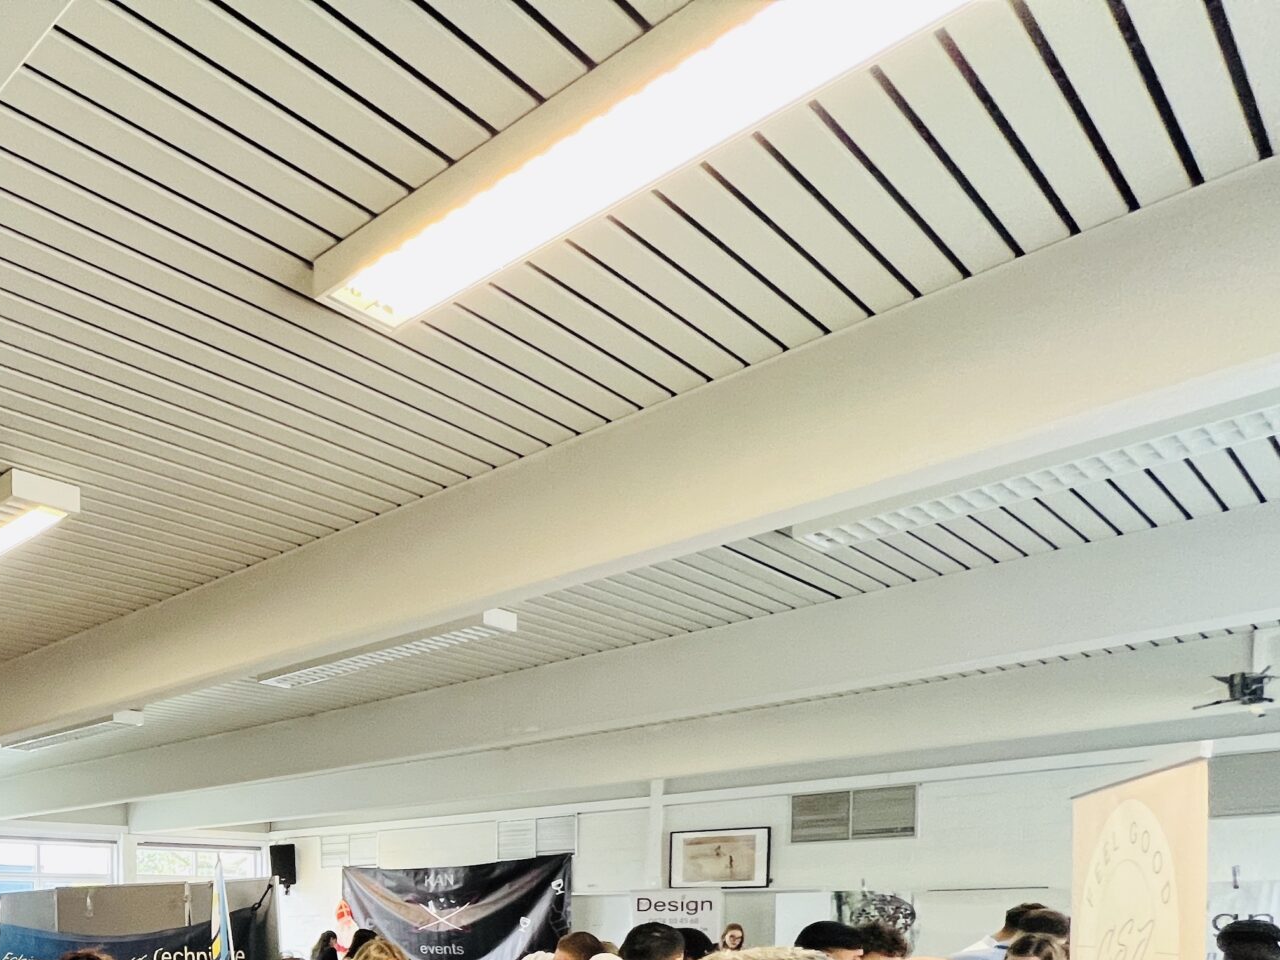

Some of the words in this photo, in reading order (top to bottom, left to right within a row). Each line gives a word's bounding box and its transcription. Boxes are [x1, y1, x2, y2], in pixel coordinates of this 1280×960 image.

[1129, 821, 1171, 905] GOOD
[424, 873, 455, 888] KAN
[636, 896, 713, 915] Design
[420, 943, 465, 955] events
